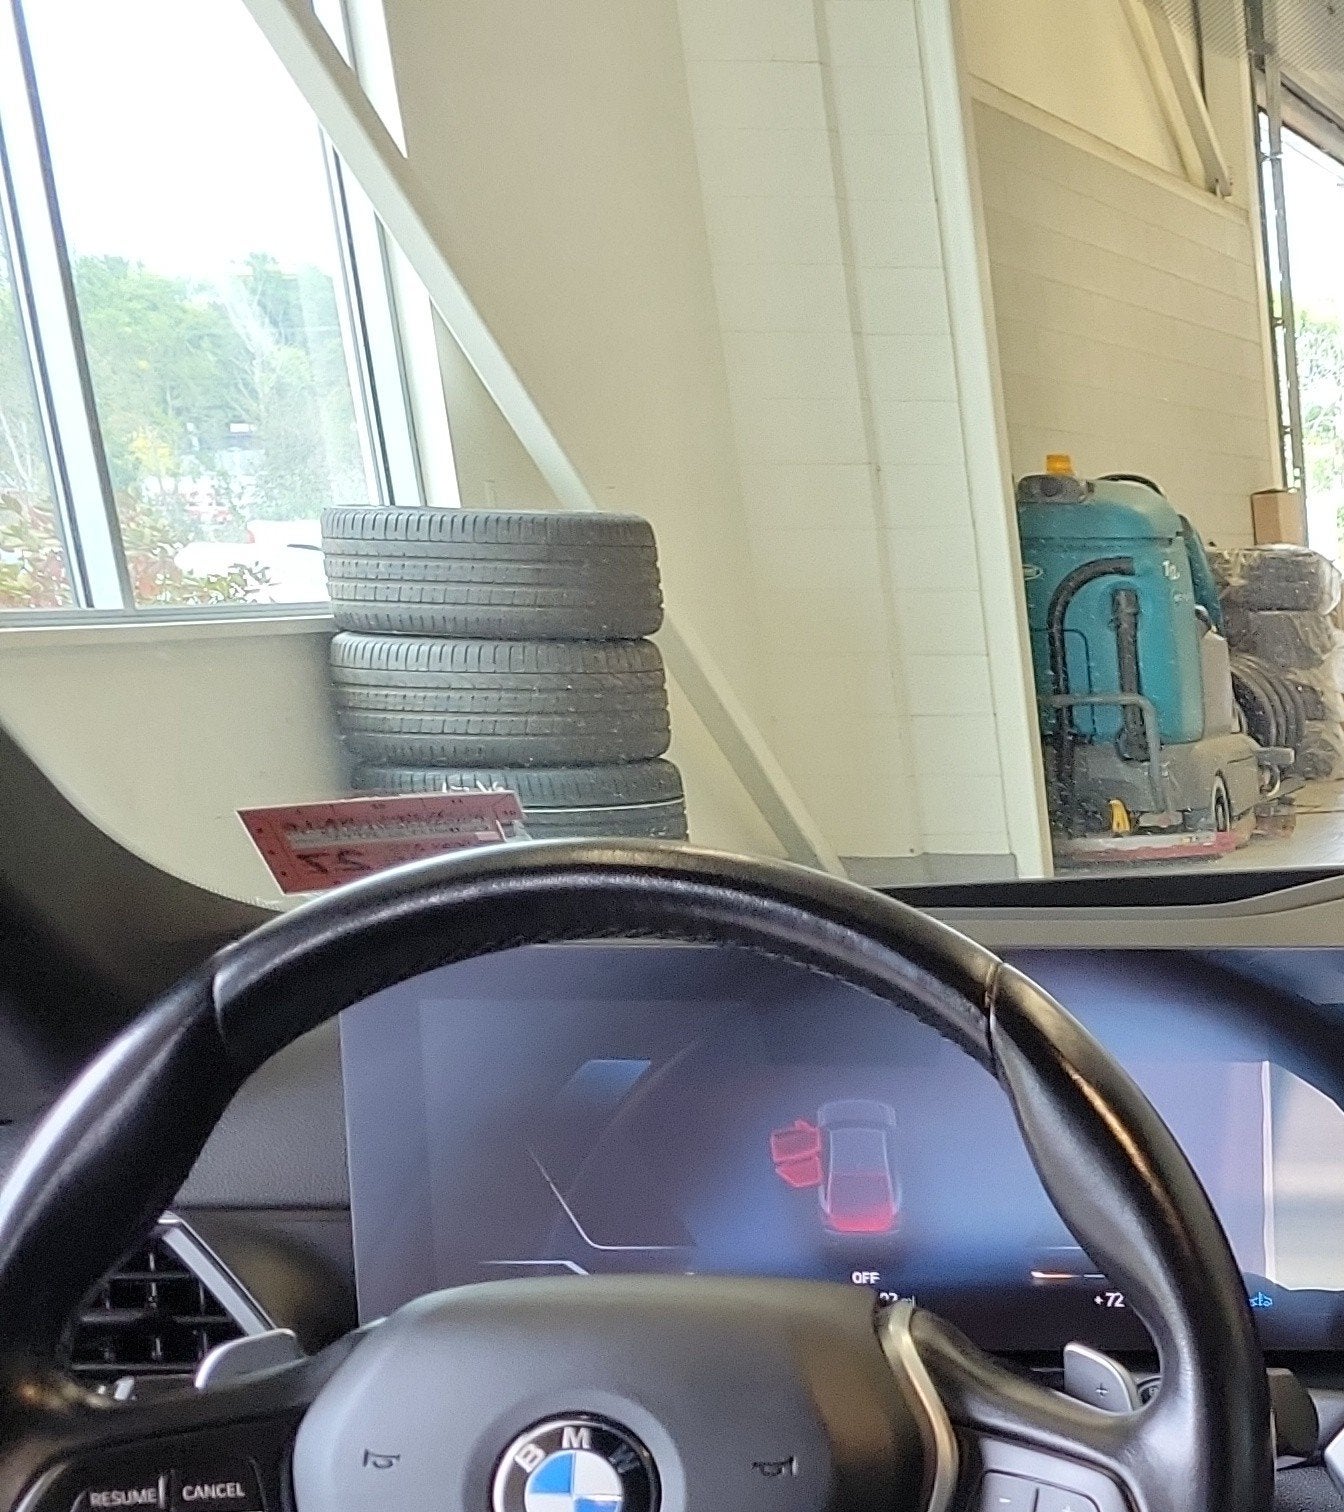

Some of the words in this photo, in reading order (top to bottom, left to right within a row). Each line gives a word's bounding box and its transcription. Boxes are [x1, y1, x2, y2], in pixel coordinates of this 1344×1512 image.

[851, 1270, 880, 1285] OFF
[513, 1426, 641, 1474] BMW
[89, 1488, 157, 1508] RESUME
[182, 1481, 246, 1501] CANCEL
